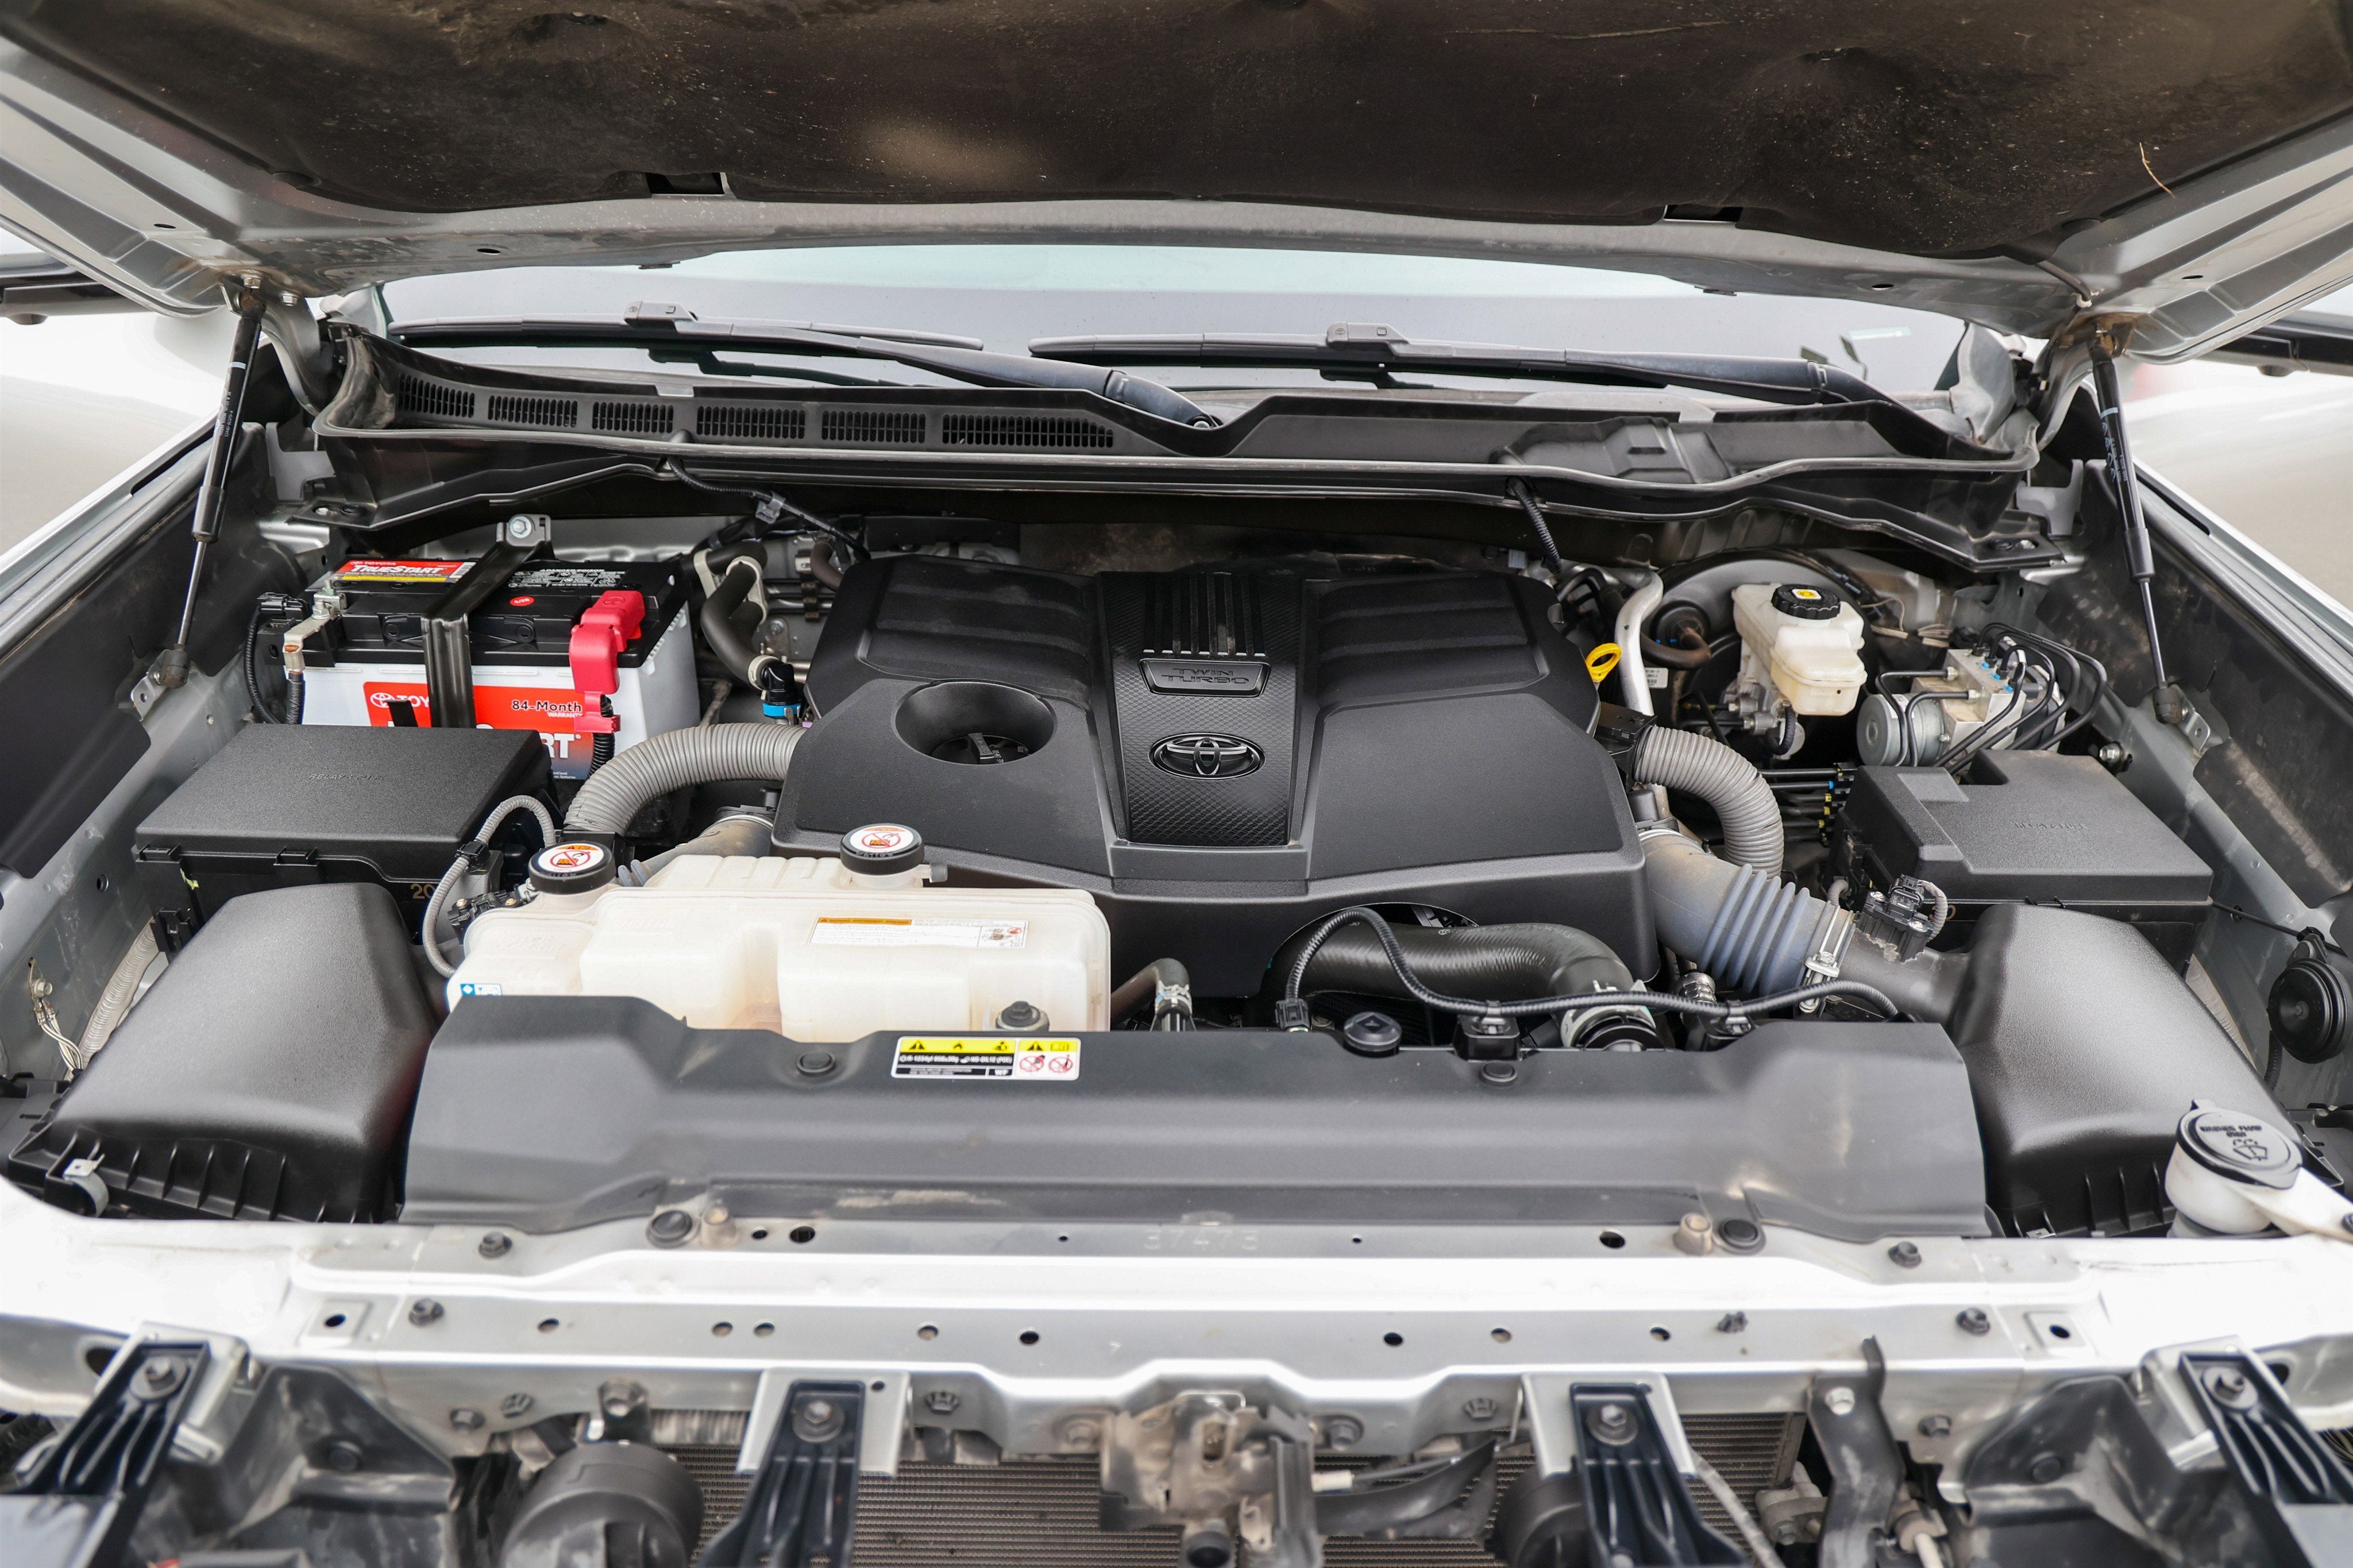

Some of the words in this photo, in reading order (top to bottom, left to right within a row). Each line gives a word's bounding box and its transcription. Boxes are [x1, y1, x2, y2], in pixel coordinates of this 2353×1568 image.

[1172, 668, 1235, 676] TWIN
[1161, 674, 1249, 684] TURBO
[511, 700, 582, 713] 84-Month
